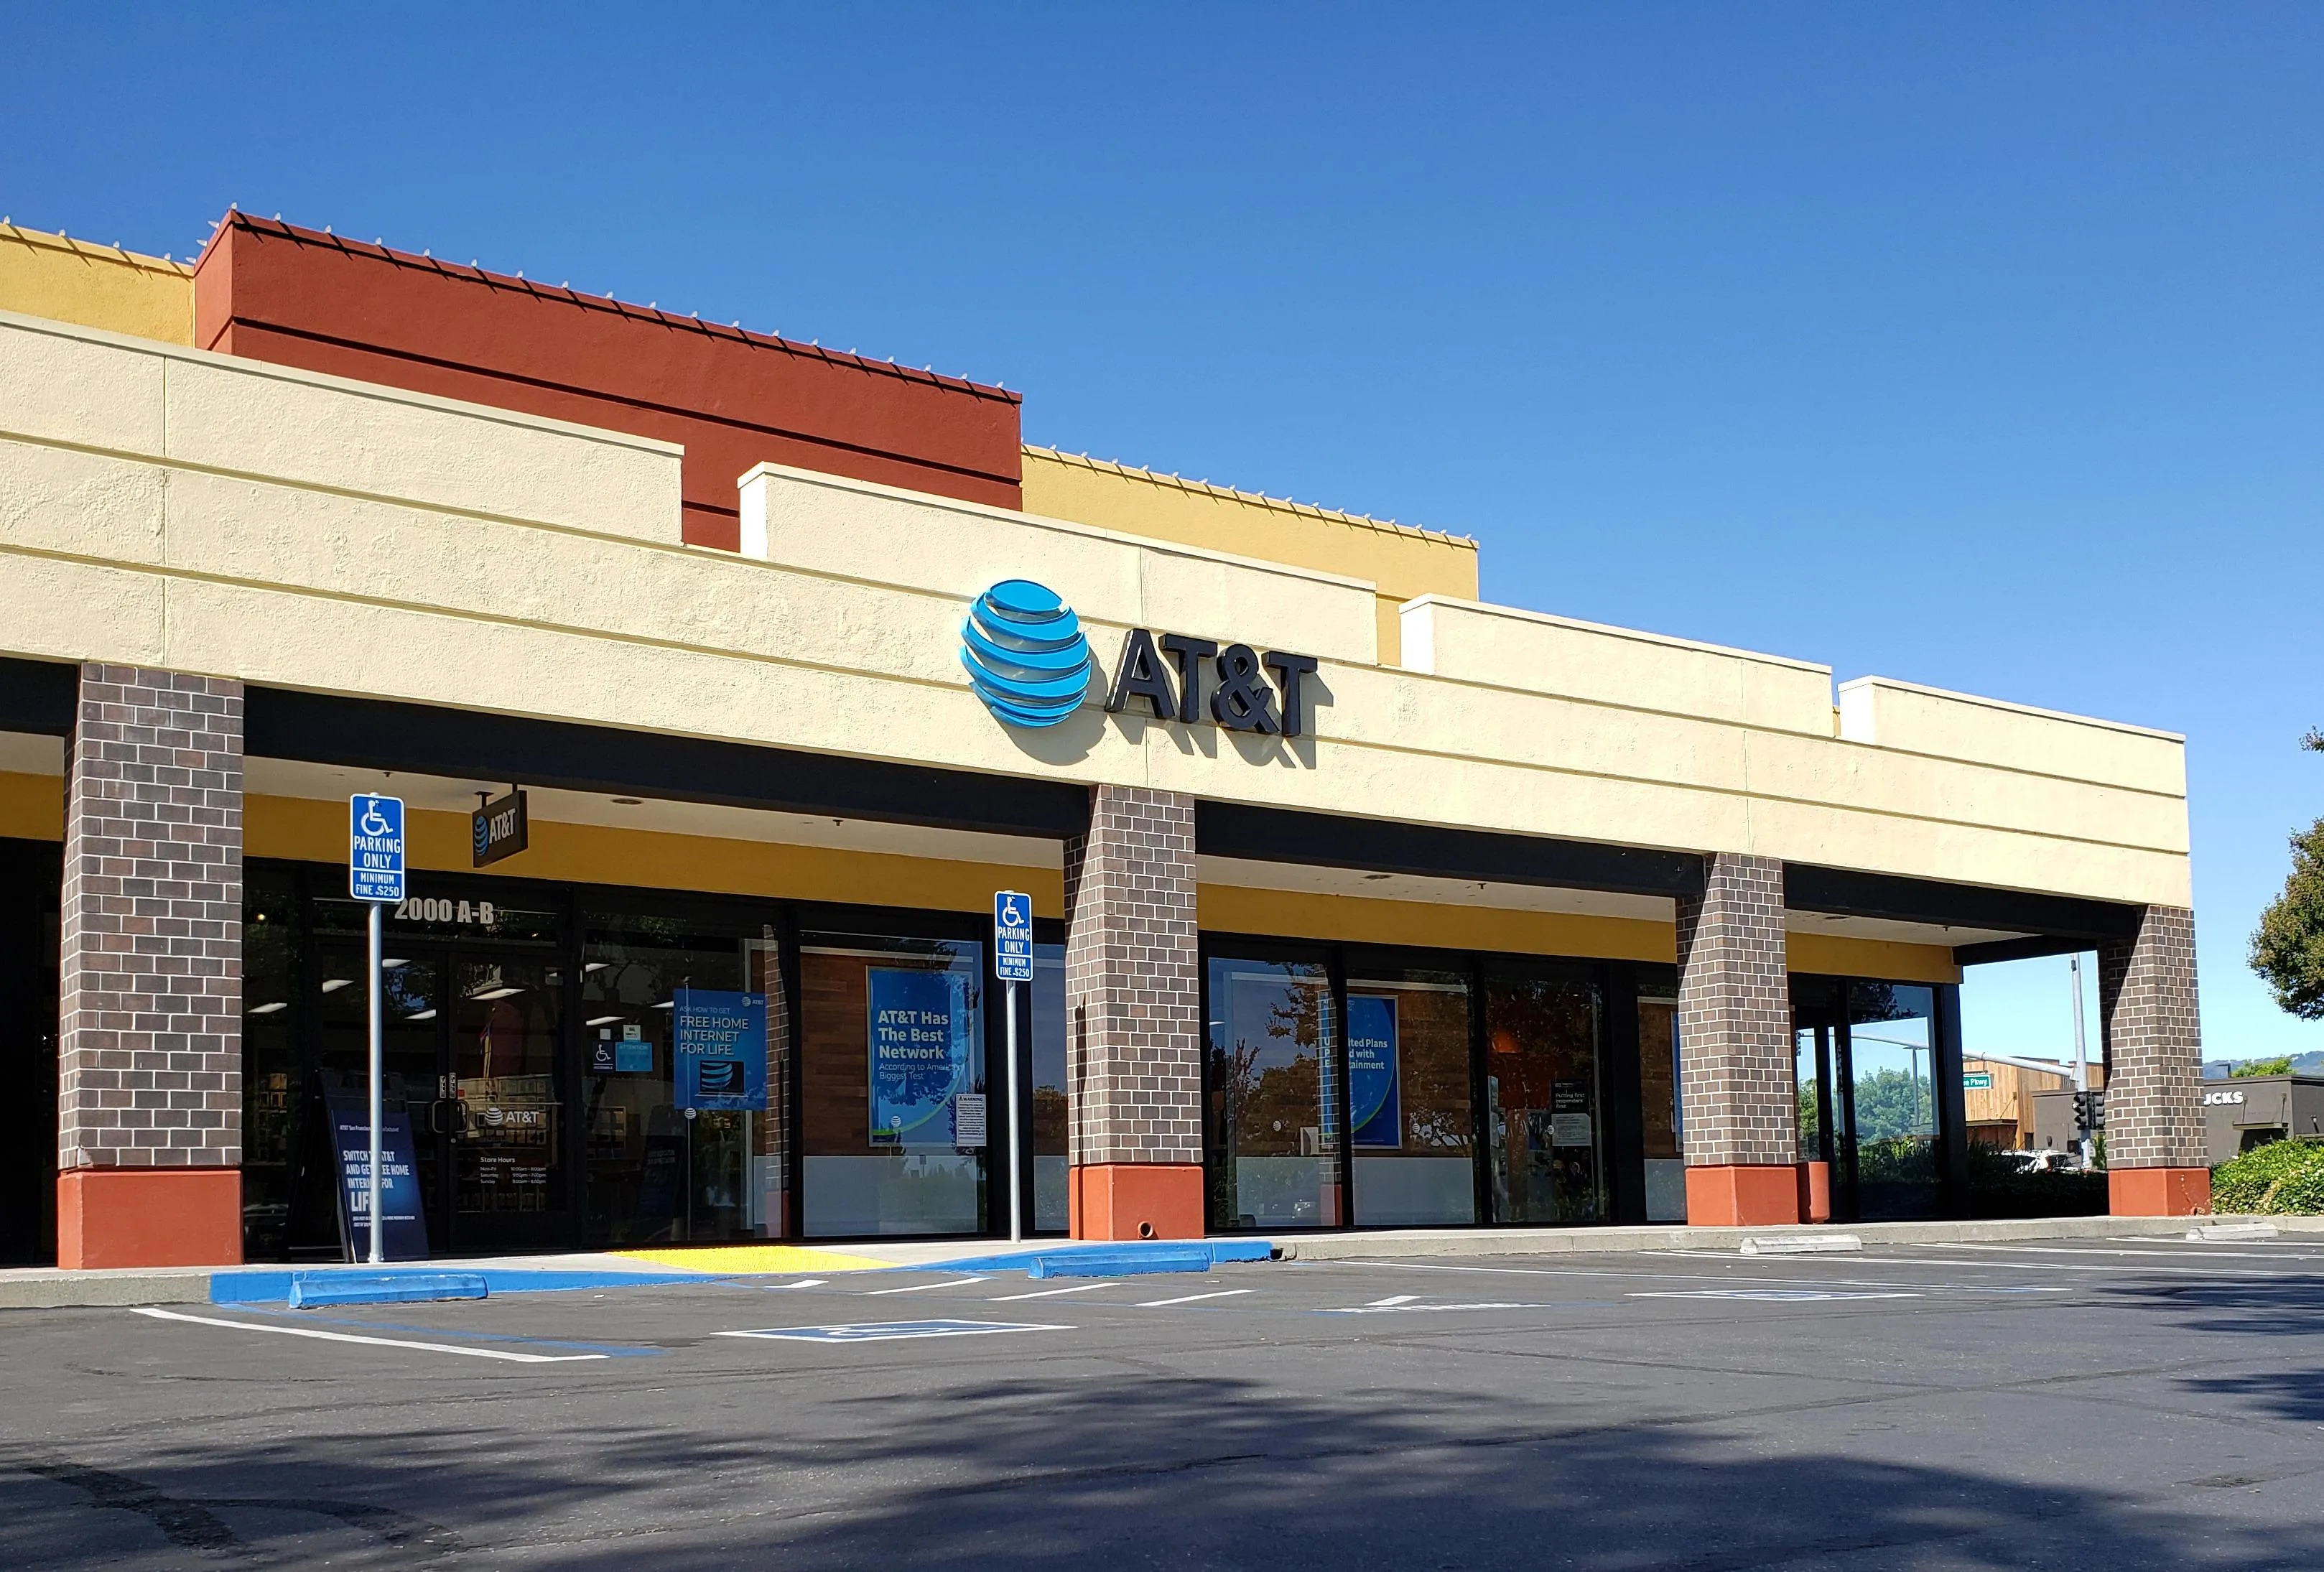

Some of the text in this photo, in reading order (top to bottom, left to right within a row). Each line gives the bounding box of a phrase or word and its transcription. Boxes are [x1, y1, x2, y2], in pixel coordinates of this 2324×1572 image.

[1105, 628, 1318, 737] AT&T
[489, 808, 516, 845] AT&T
[353, 836, 401, 854] PARKING
[363, 852, 392, 869] ONLY
[361, 872, 394, 884] MINIMUM
[355, 884, 373, 896] FINE
[394, 897, 494, 924] 2000 A-B
[998, 926, 1030, 941] PARKING
[1004, 941, 1024, 954] ONLY
[1003, 957, 1026, 967] MINIMUM
[1000, 967, 1012, 976] FINE
[680, 1016, 749, 1029] FREE HOME
[878, 1010, 949, 1025] AT&T Has
[680, 1029, 740, 1042] INTERNET
[878, 1028, 944, 1042] The Best
[680, 1043, 705, 1054] FOR
[1366, 1038, 1388, 1048] Plans
[879, 1046, 944, 1059] Network
[1356, 1049, 1375, 1059] with
[879, 1063, 916, 1073] According
[880, 1071, 906, 1081] Biggest
[1970, 1078, 1988, 1087] Pkwy
[506, 1111, 539, 1123] AT&T
[343, 1150, 369, 1161] SWITCH
[346, 1164, 360, 1175] AND
[391, 1165, 409, 1176] HOME
[382, 1178, 394, 1189] FOR
[351, 1191, 371, 1211] LIF
